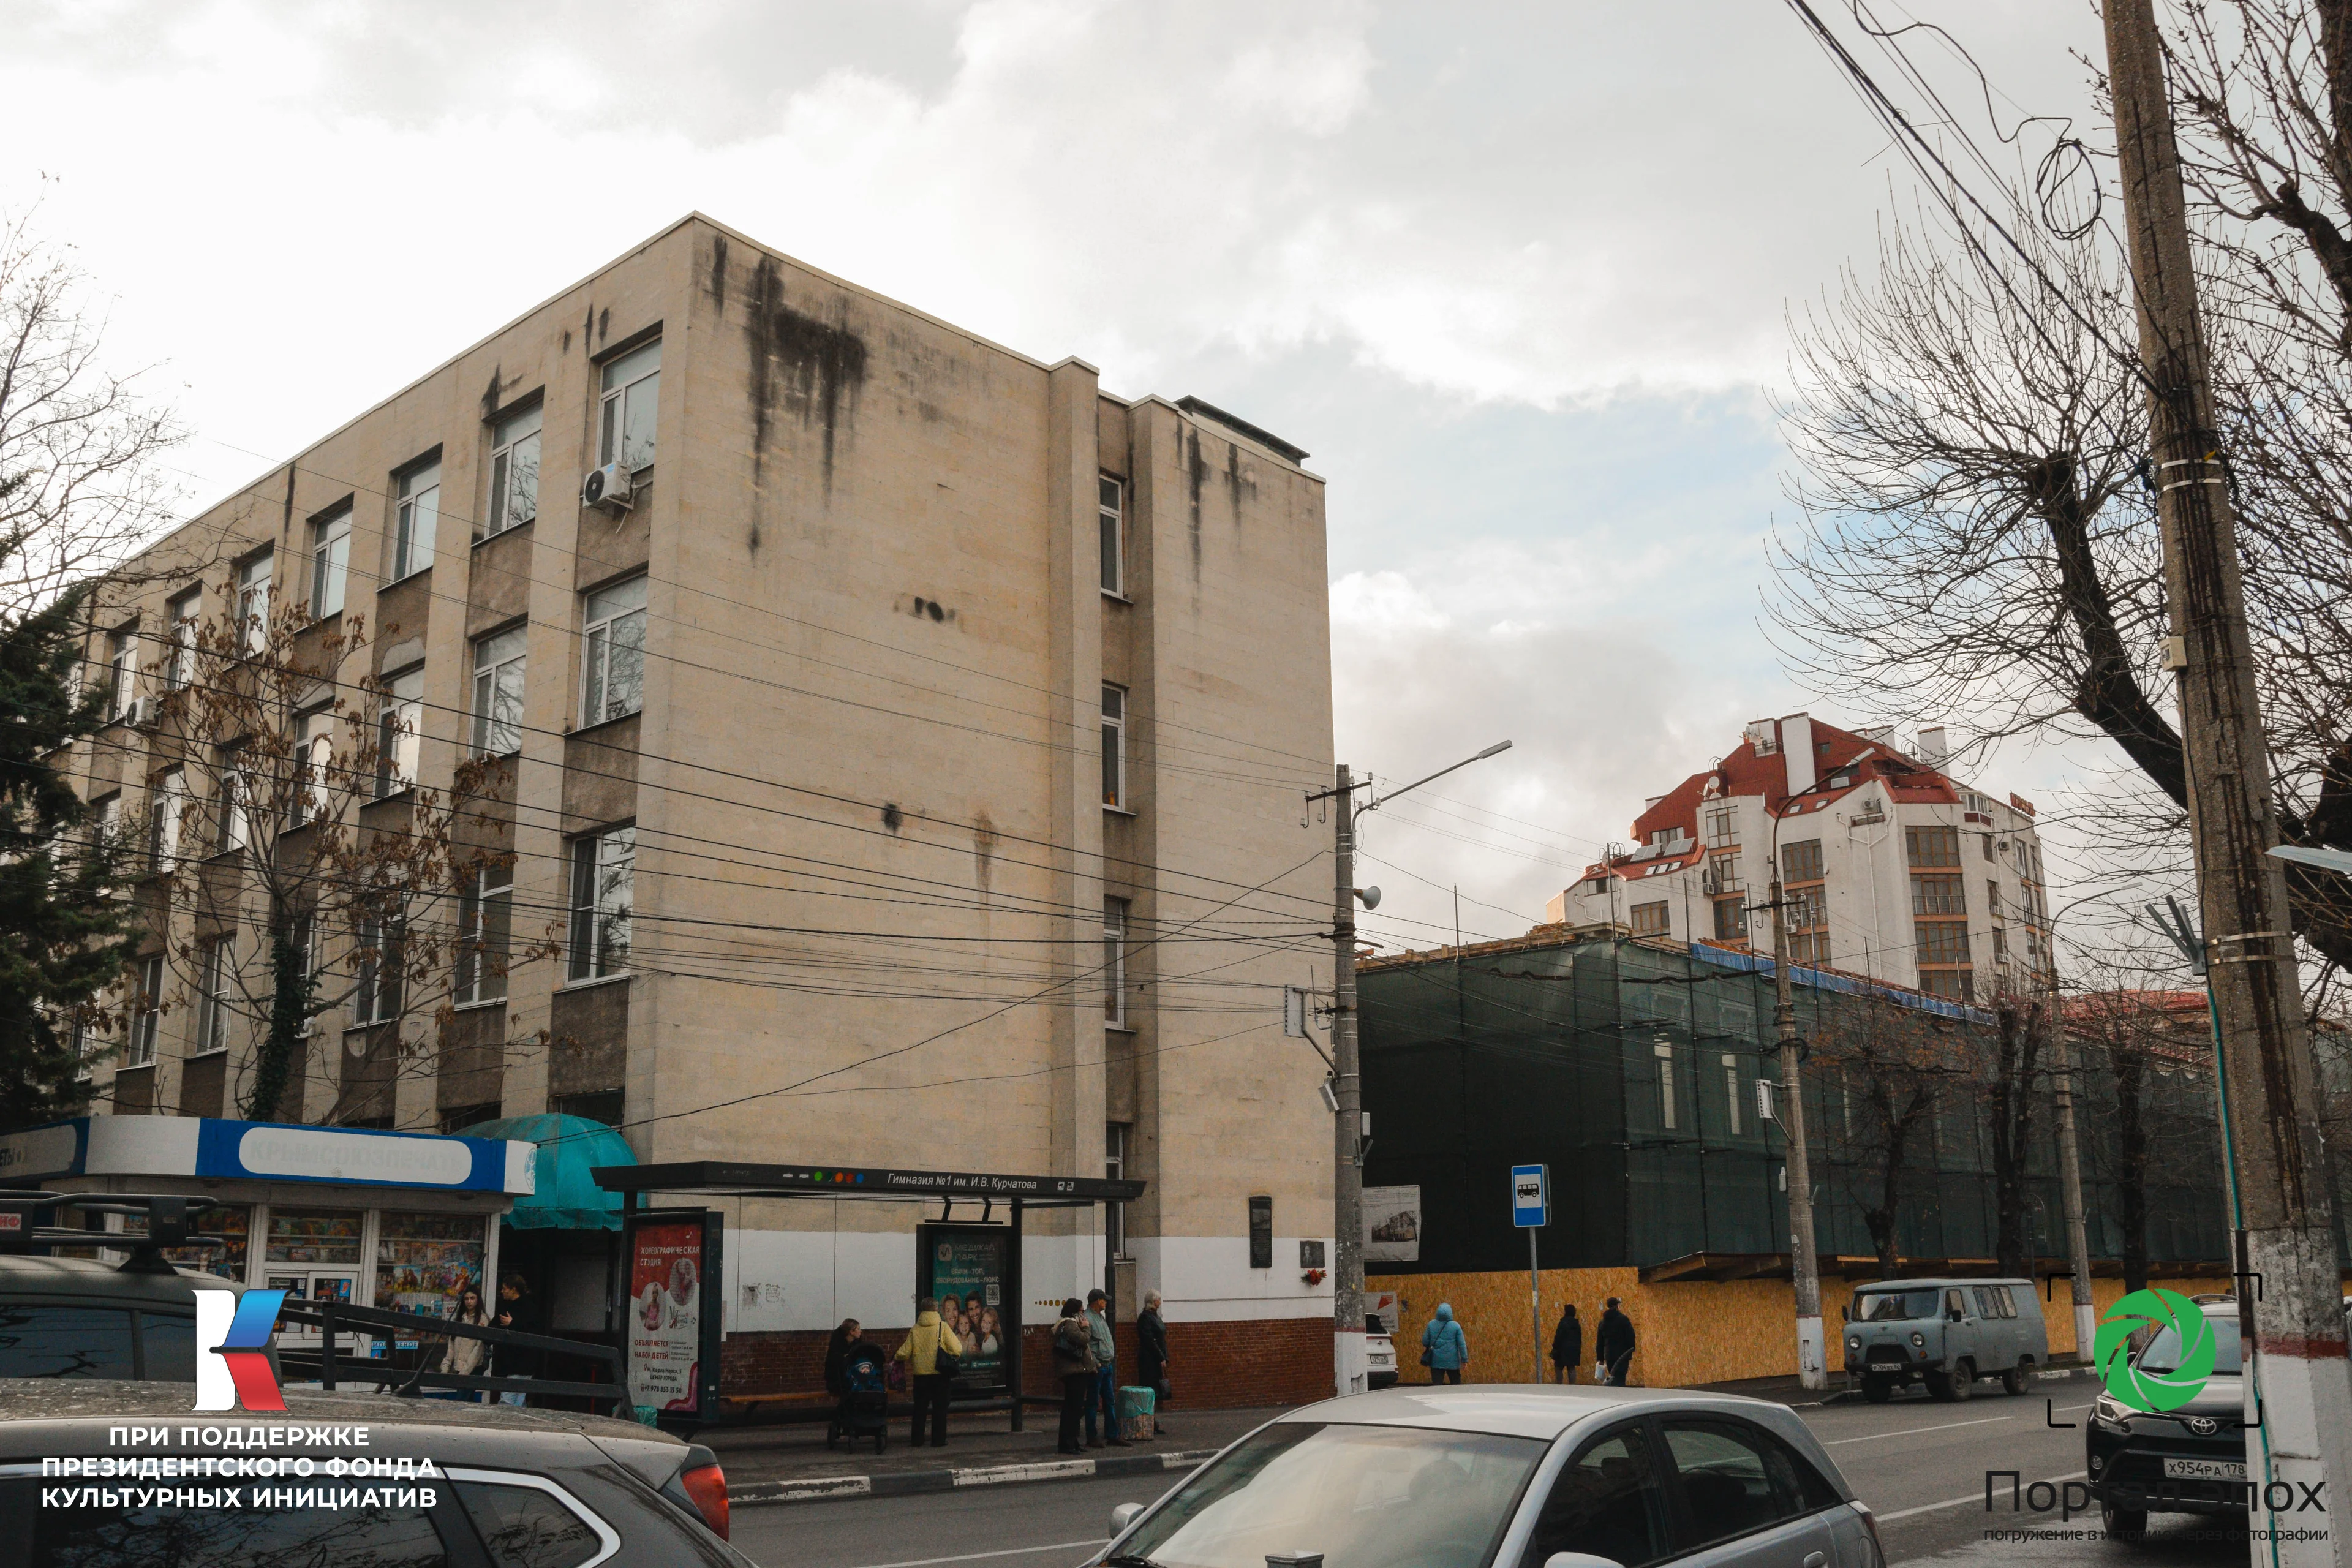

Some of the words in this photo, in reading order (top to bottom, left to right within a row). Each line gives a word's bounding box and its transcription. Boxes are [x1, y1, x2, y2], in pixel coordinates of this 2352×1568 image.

[888, 1173, 933, 1185] Гимназия
[953, 1178, 968, 1188] им.
[971, 1177, 990, 1188] И.В.
[992, 1178, 1038, 1190] Курчатова
[641, 1246, 699, 1255] ХОРЕОГРАФИЧЕСКАЯ
[640, 1258, 662, 1267] СТУДИЯ
[2169, 1461, 2222, 1477] Х954РА
[2225, 1463, 2244, 1474] 178
